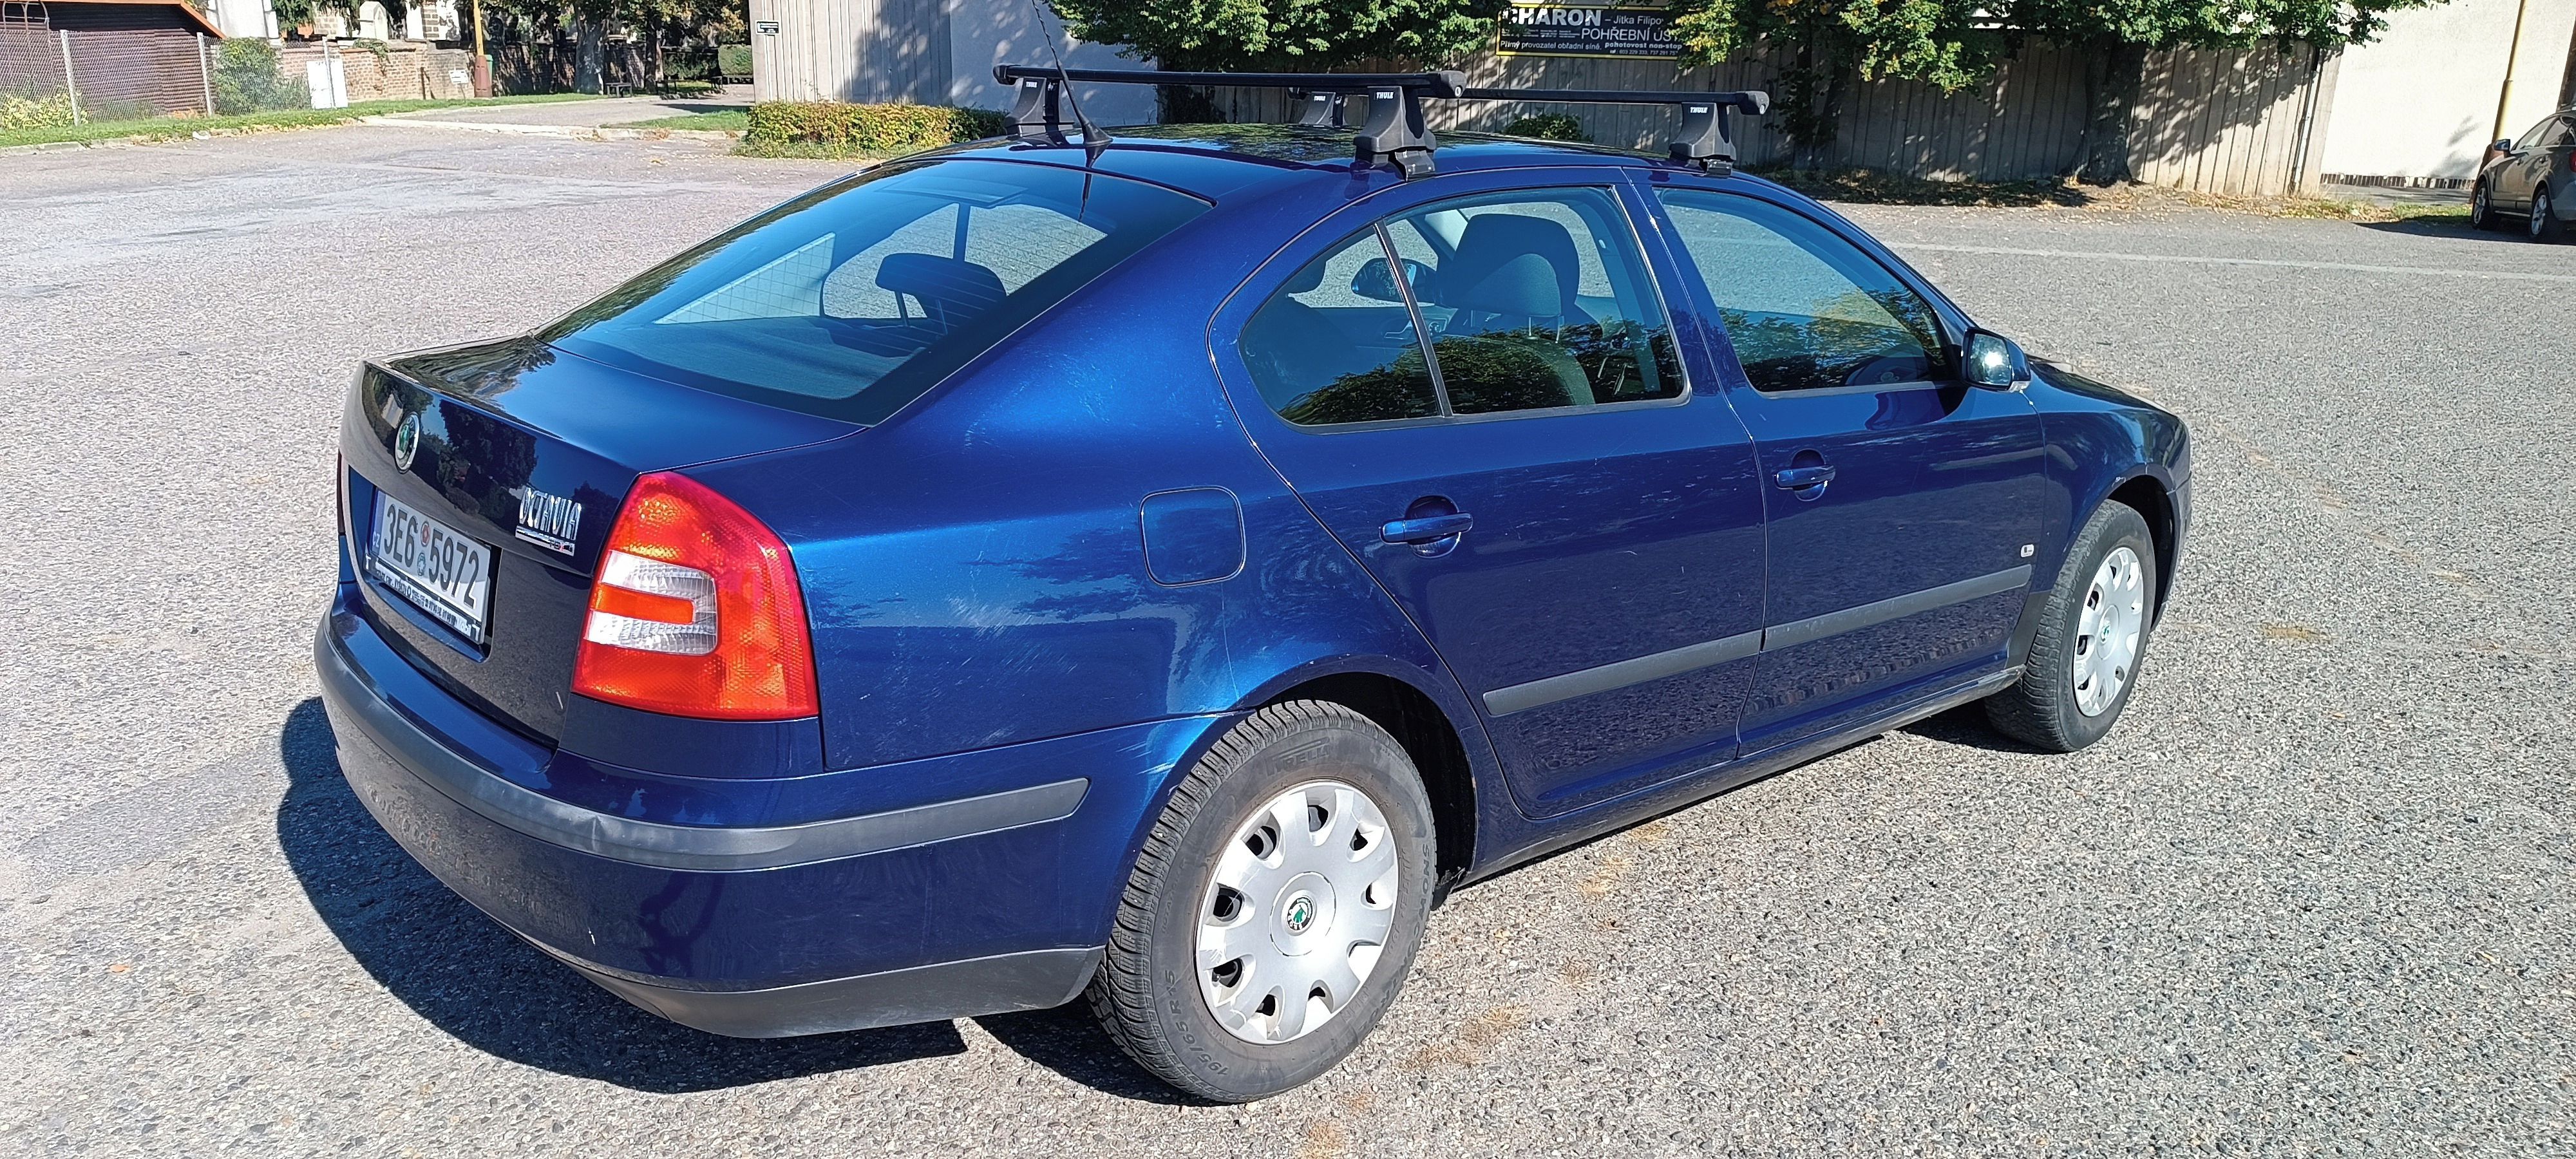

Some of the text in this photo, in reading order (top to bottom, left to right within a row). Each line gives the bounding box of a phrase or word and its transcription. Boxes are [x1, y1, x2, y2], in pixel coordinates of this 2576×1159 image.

[1502, 8, 1602, 27] CHARON
[1613, 15, 1634, 24] Jitka
[1521, 41, 1557, 50] provozatel
[1557, 42, 1584, 50] obřadní
[1581, 26, 1651, 41] POHŘEBNÍ
[1653, 27, 1678, 42] ÚS
[519, 487, 582, 541] OCTAVIA
[372, 530, 381, 549] CZ
[384, 504, 418, 568] 3E6
[428, 528, 480, 610] 5972
[1265, 737, 1331, 777] PIRELLI
[1175, 1021, 1229, 1075] 195/65
